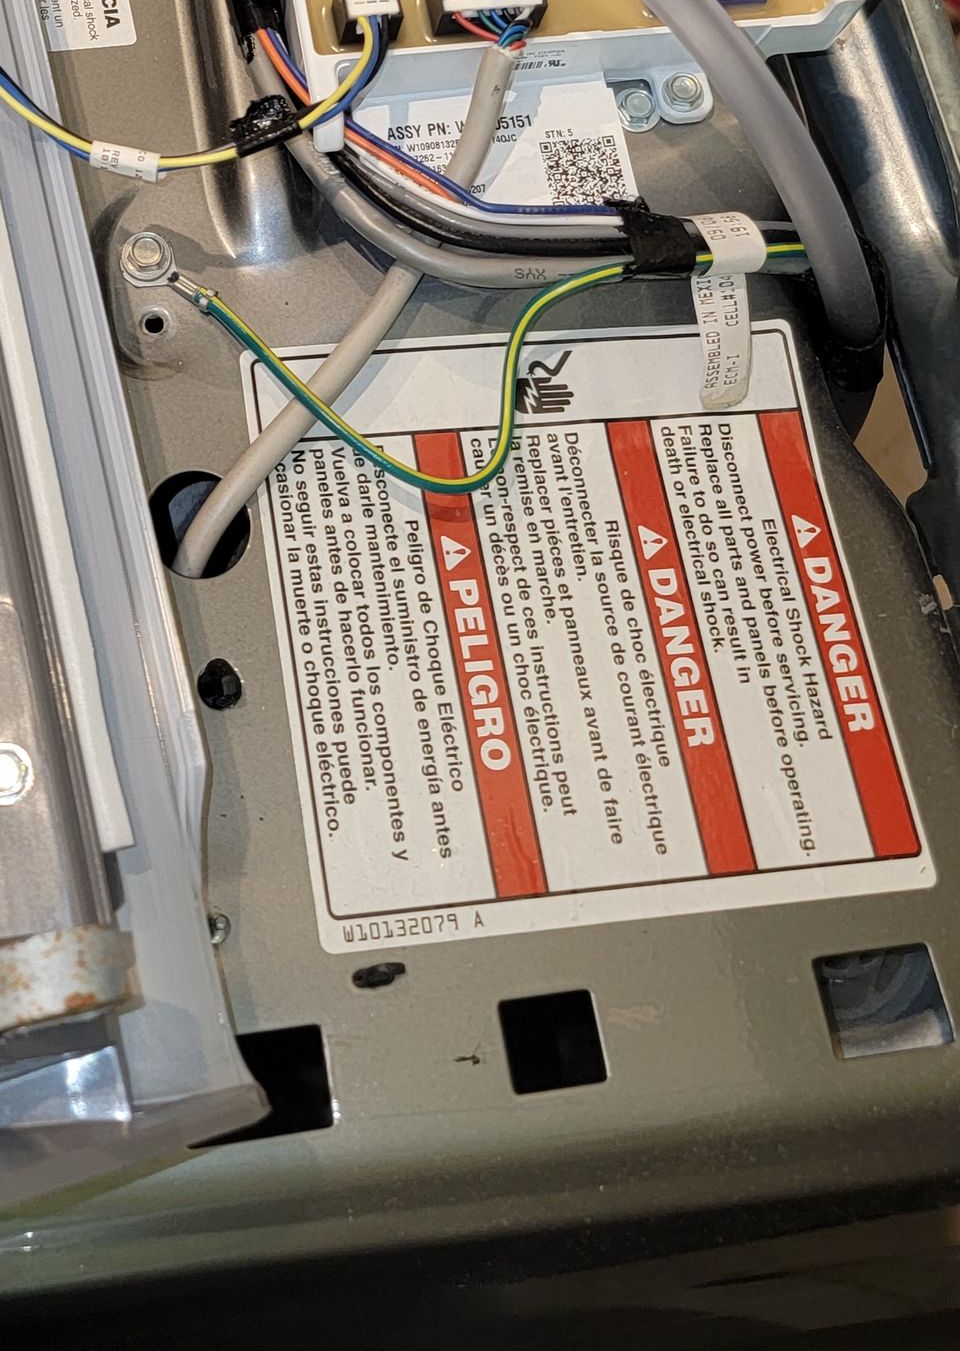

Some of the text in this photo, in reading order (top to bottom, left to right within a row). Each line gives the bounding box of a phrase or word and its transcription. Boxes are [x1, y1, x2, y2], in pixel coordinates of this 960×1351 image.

[85, 12, 100, 41] shock
[387, 124, 421, 141] ASSY
[427, 121, 451, 137] PN:
[545, 128, 574, 139] STN: 5
[702, 310, 718, 325] IN
[704, 331, 721, 389] ASSEMBLED
[483, 504, 497, 526] un
[512, 457, 534, 516] remise
[546, 433, 587, 582] avant l'entretien.
[287, 547, 302, 563] la
[389, 557, 405, 572] el
[488, 532, 510, 587] décès
[526, 522, 542, 544] en
[660, 426, 725, 653] death or electrical shock.
[677, 425, 751, 684] Failure to do so can result in
[290, 569, 312, 636] muerte
[356, 473, 400, 671] darle mantenimiento.
[501, 592, 516, 616] ou
[516, 578, 532, 601] de
[531, 550, 556, 624] marche.
[717, 423, 809, 748] Disconnect power before servicing.
[291, 450, 358, 804] No seguir estas instrucciones puede
[301, 642, 313, 654] o
[308, 448, 377, 791] paneles antes de hacerlo funcionar.
[331, 446, 409, 861] Vuelva a colocar todos los componentes y
[393, 579, 421, 682] suministro
[404, 520, 463, 792] Peligro de Choque Eléctrico
[507, 623, 521, 646] un
[522, 607, 538, 639] ces
[526, 435, 622, 844] Replacer piéces et panneaux avant de faire
[564, 432, 667, 855] Déconnecter la source de courant électrique
[604, 520, 670, 767] Risque de choc électrique
[698, 424, 816, 857] Replace all parts and panels before operating.
[761, 519, 833, 740] Electrical Shock Hazard
[803, 557, 874, 731] DANGER
[449, 579, 511, 771] PELIGRO
[513, 653, 532, 700] choc
[648, 568, 714, 747] DANGER
[304, 660, 325, 735] choque
[412, 688, 428, 712] de
[529, 646, 564, 764] instructions
[316, 741, 340, 838] eléctrico.
[417, 718, 444, 795] energía
[524, 706, 553, 813] électrique.
[551, 770, 577, 816] peut
[431, 801, 452, 859] antes
[342, 910, 485, 943] W10132079 A
